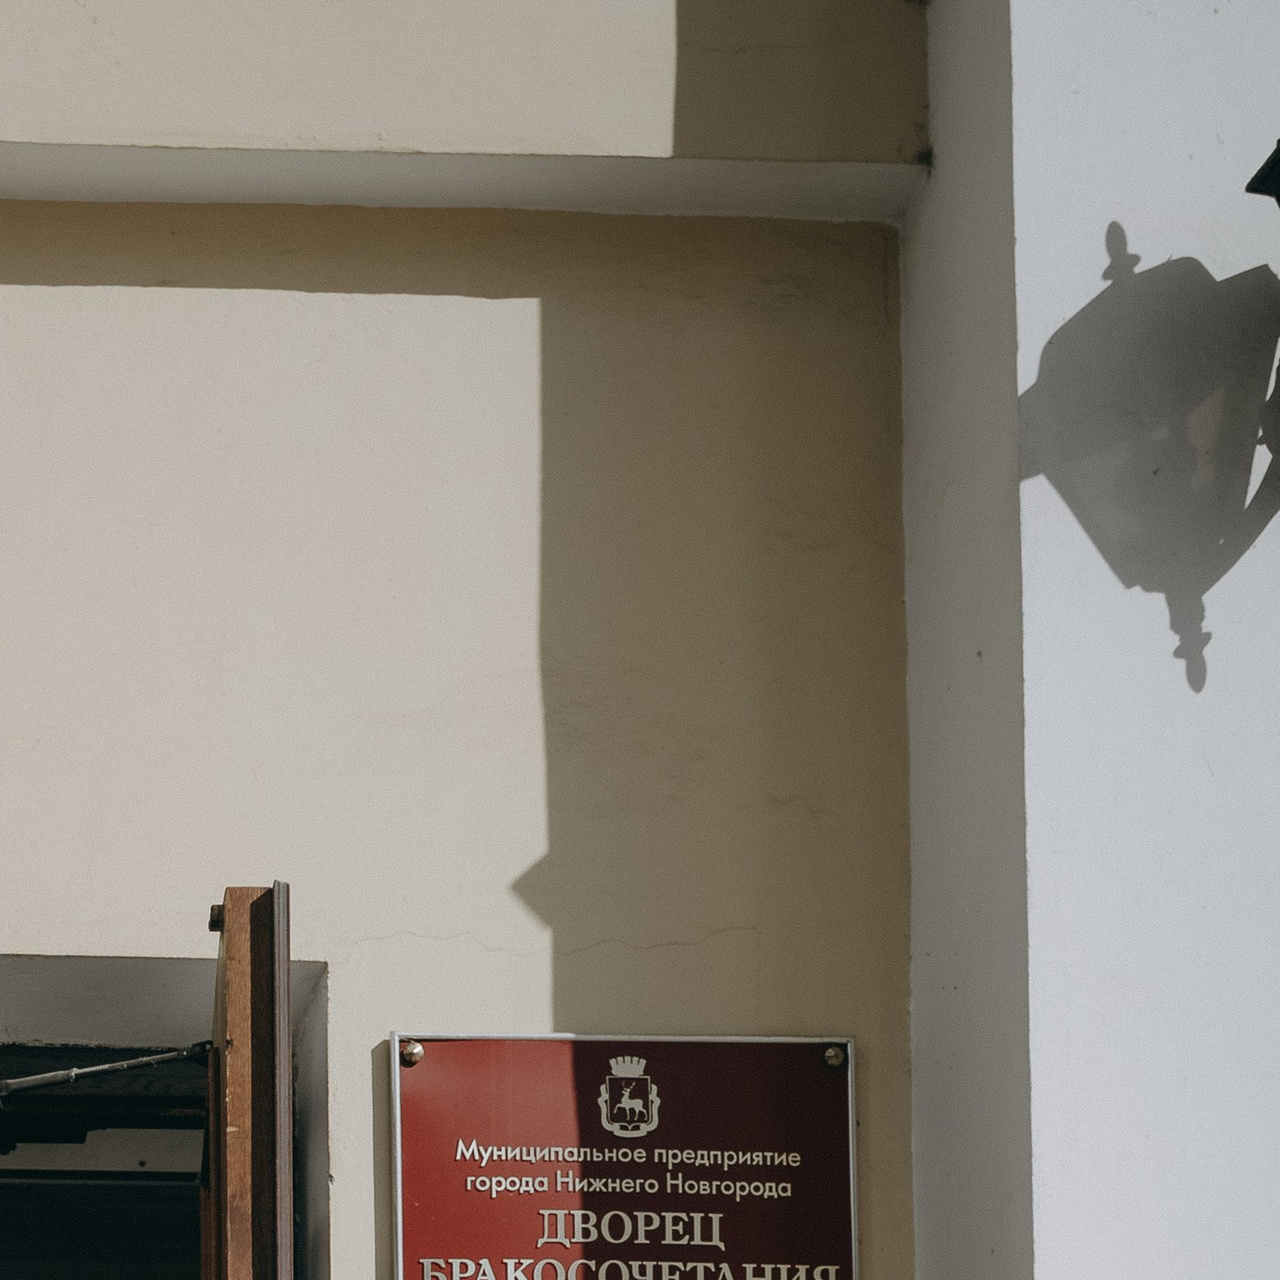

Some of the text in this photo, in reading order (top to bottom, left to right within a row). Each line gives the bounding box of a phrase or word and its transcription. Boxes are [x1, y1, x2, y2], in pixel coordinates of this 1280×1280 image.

[456, 1138, 800, 1171] Муниципальное предприятие
[467, 1170, 791, 1201] города Нижнего Новгорода
[537, 1210, 725, 1251] ДВОРЕЦ
